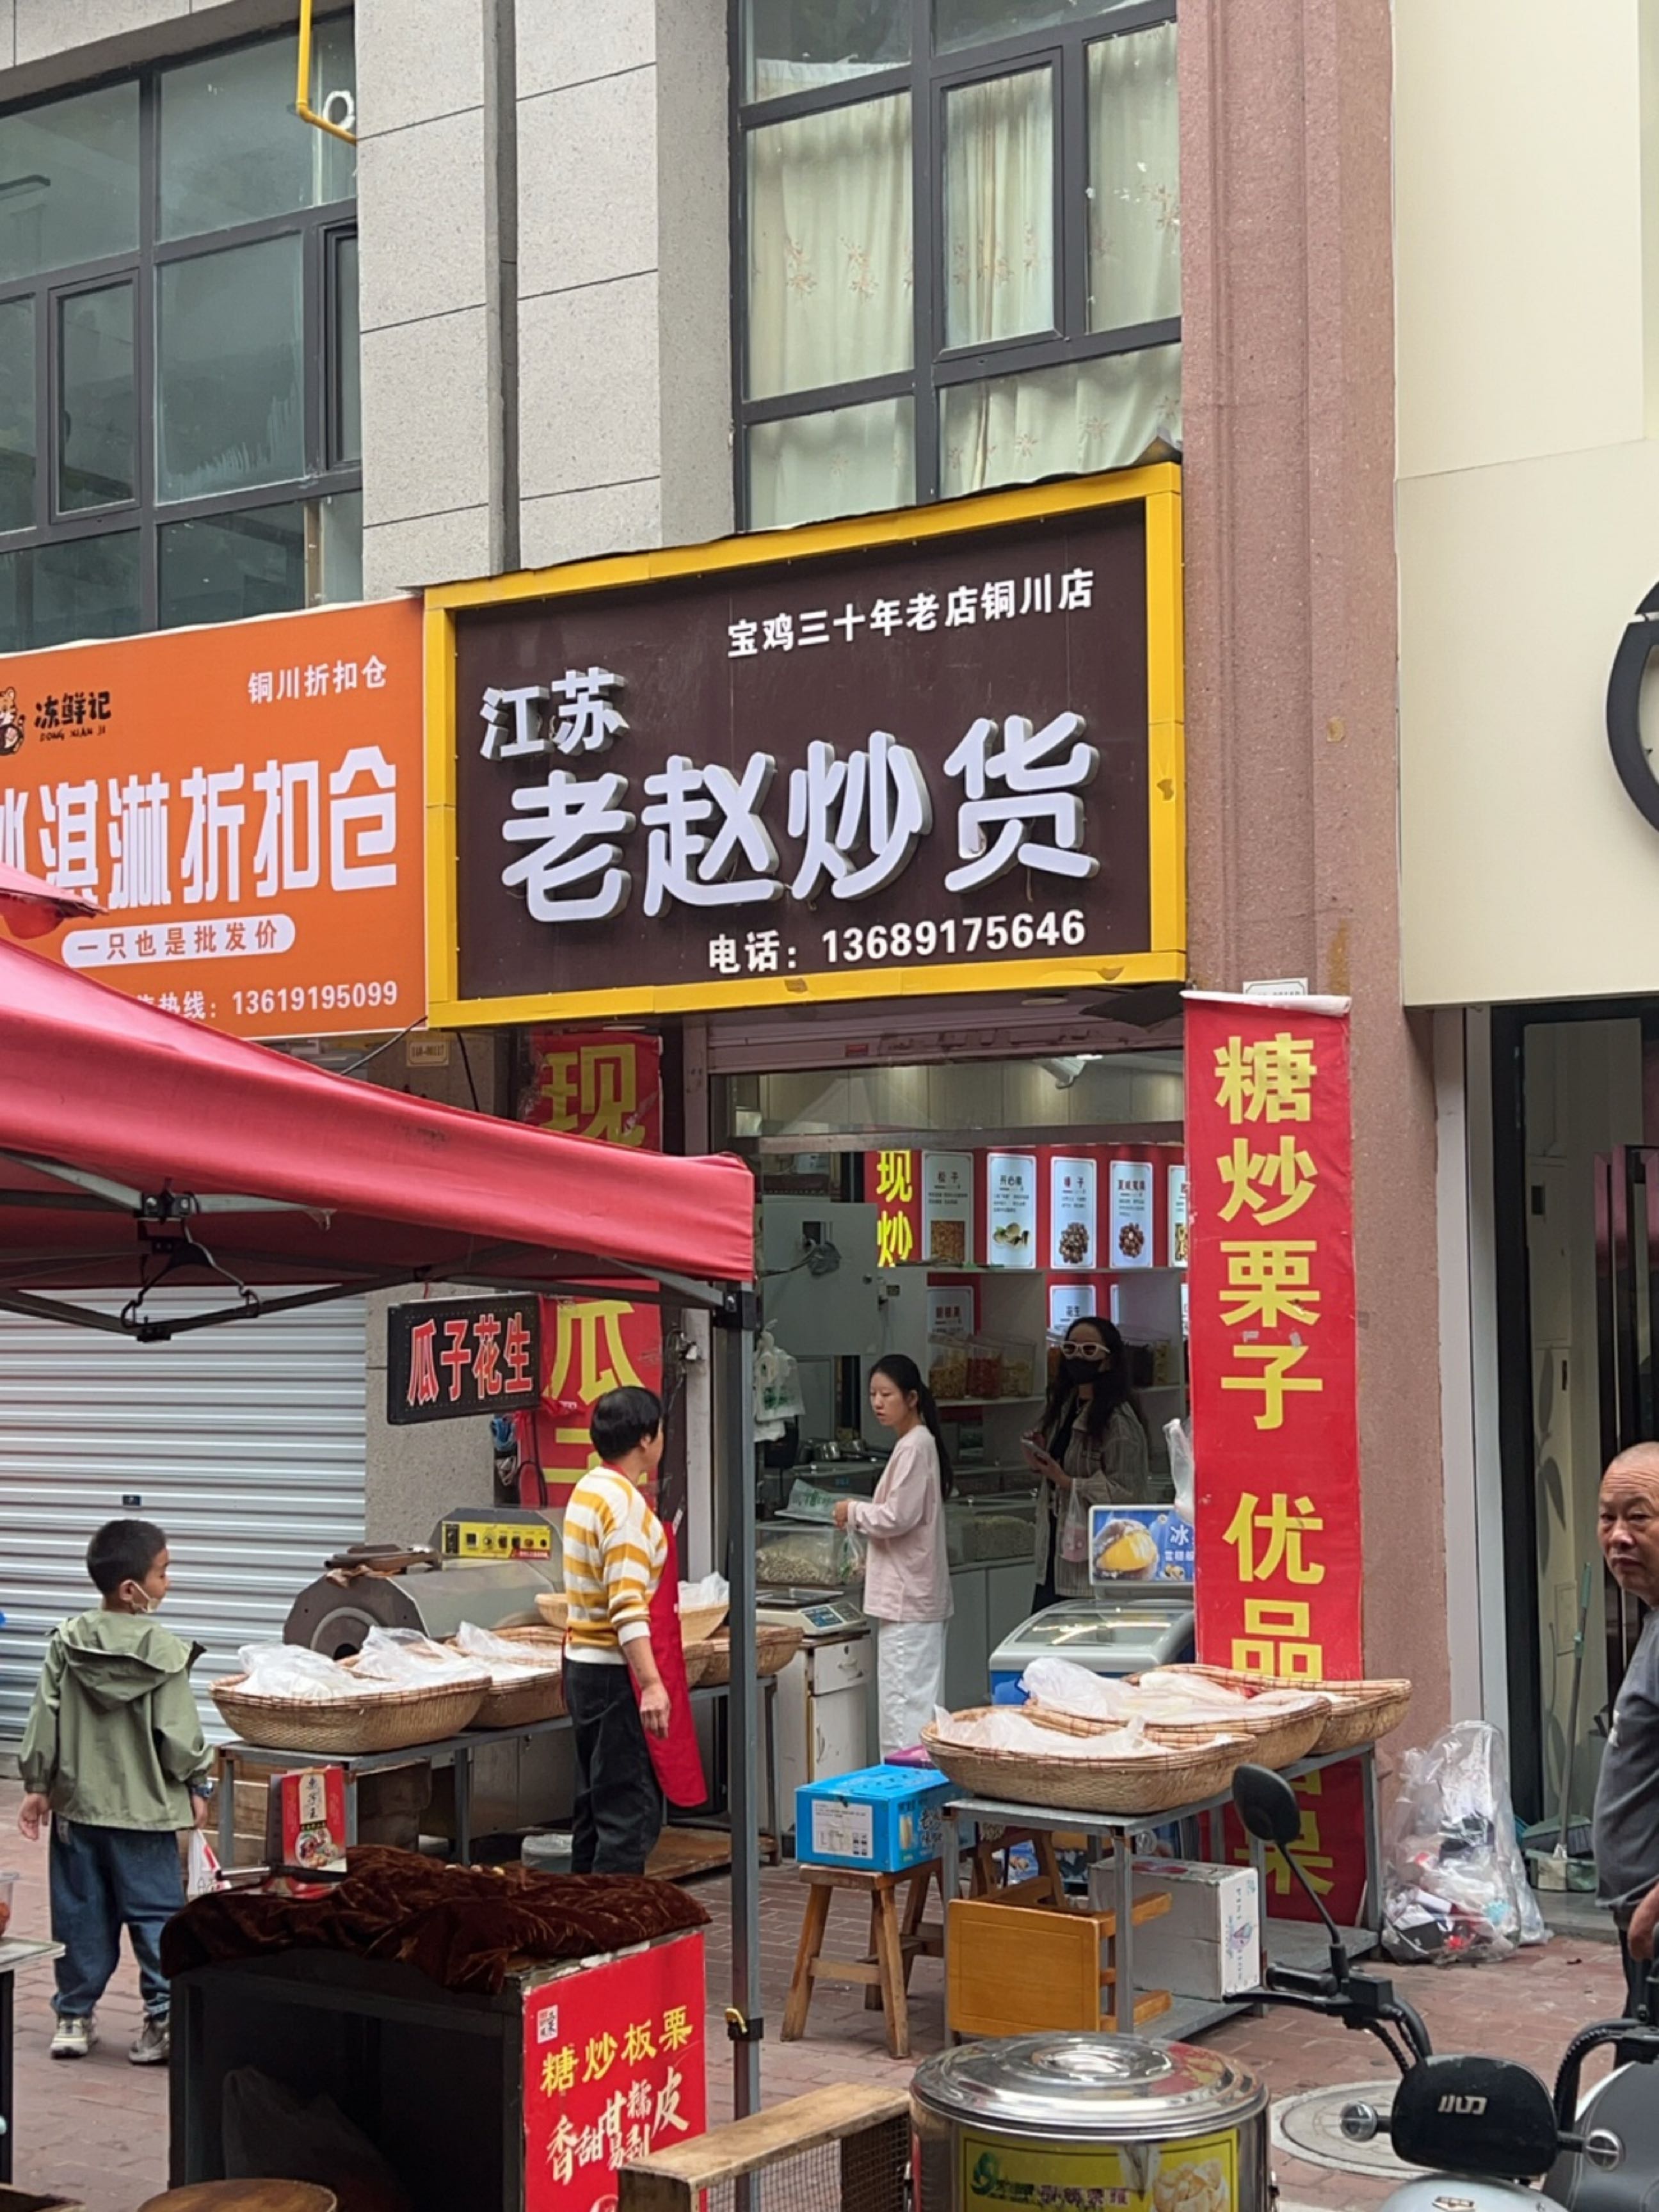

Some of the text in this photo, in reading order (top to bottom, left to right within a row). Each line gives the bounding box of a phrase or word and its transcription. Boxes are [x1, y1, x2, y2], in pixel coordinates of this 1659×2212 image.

[727, 568, 1094, 657] 宝鸡三十年老店铜川店
[35, 691, 111, 728] 冻鲜记
[248, 655, 387, 704] 铜川折扣仓
[480, 667, 627, 760] 江苏
[502, 712, 1101, 922] 老赵炒货
[77, 920, 277, 960] 一只也是批发价
[876, 1150, 913, 1268] 现炒
[1214, 1032, 1323, 1429] 糖炒栗子
[406, 1312, 533, 1406] 瓜子花生
[540, 2005, 693, 2097] 糖炒板栗
